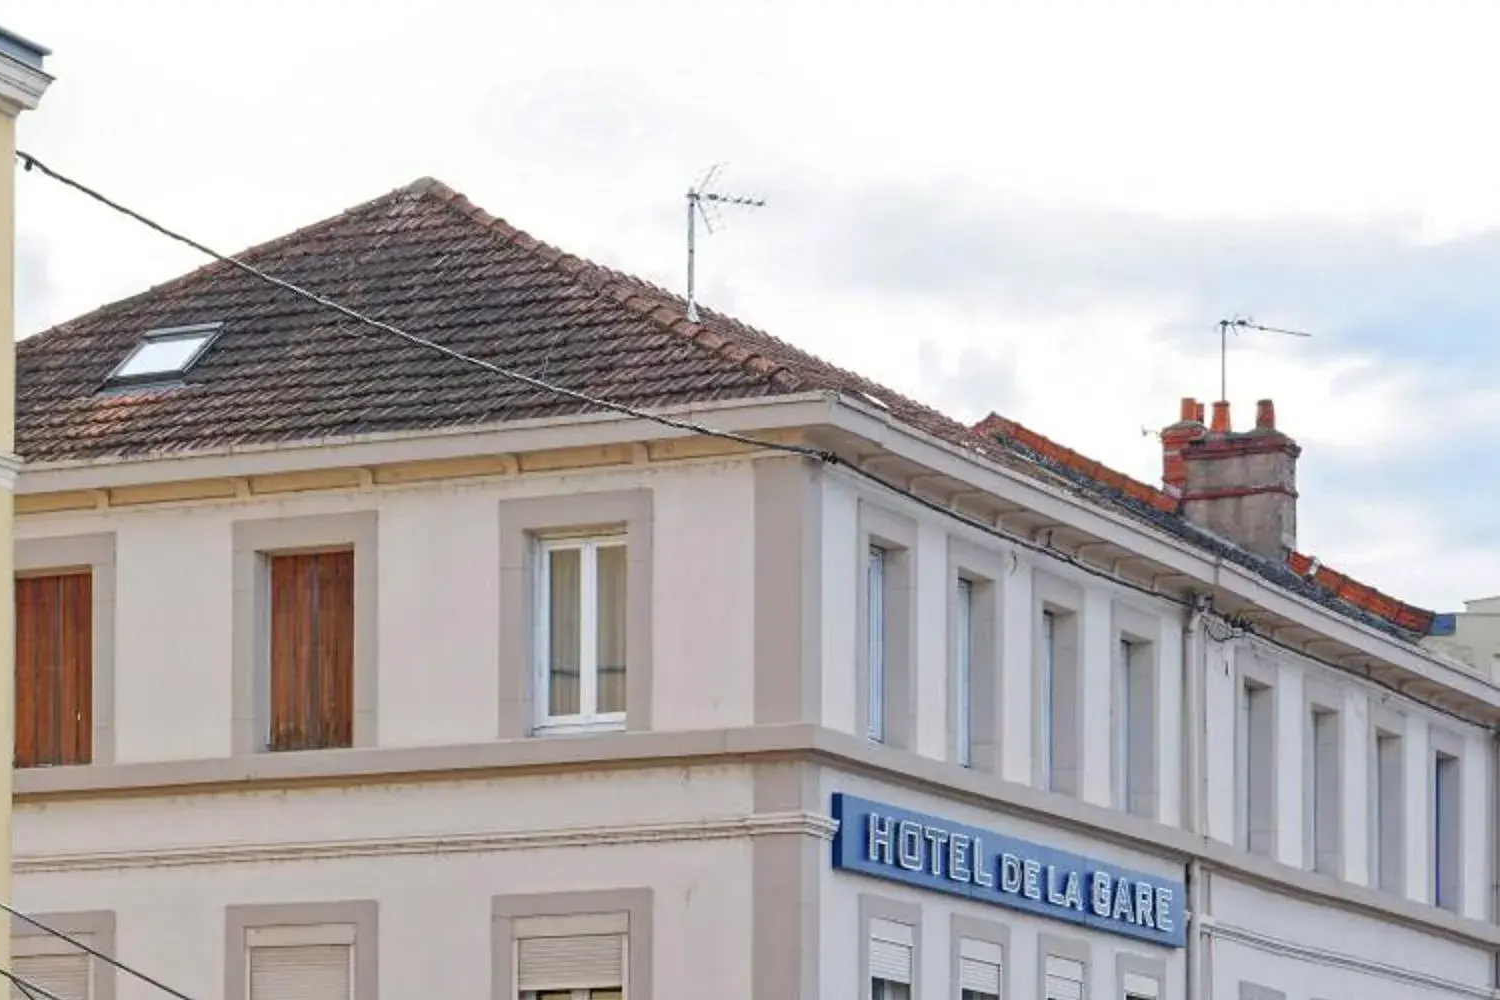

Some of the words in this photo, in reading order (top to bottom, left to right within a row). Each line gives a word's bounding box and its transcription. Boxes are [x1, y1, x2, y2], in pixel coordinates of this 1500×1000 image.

[869, 812, 993, 887] HOTEL
[1000, 853, 1041, 899] DE
[1046, 862, 1083, 911] LA
[1092, 871, 1174, 932] GARE
